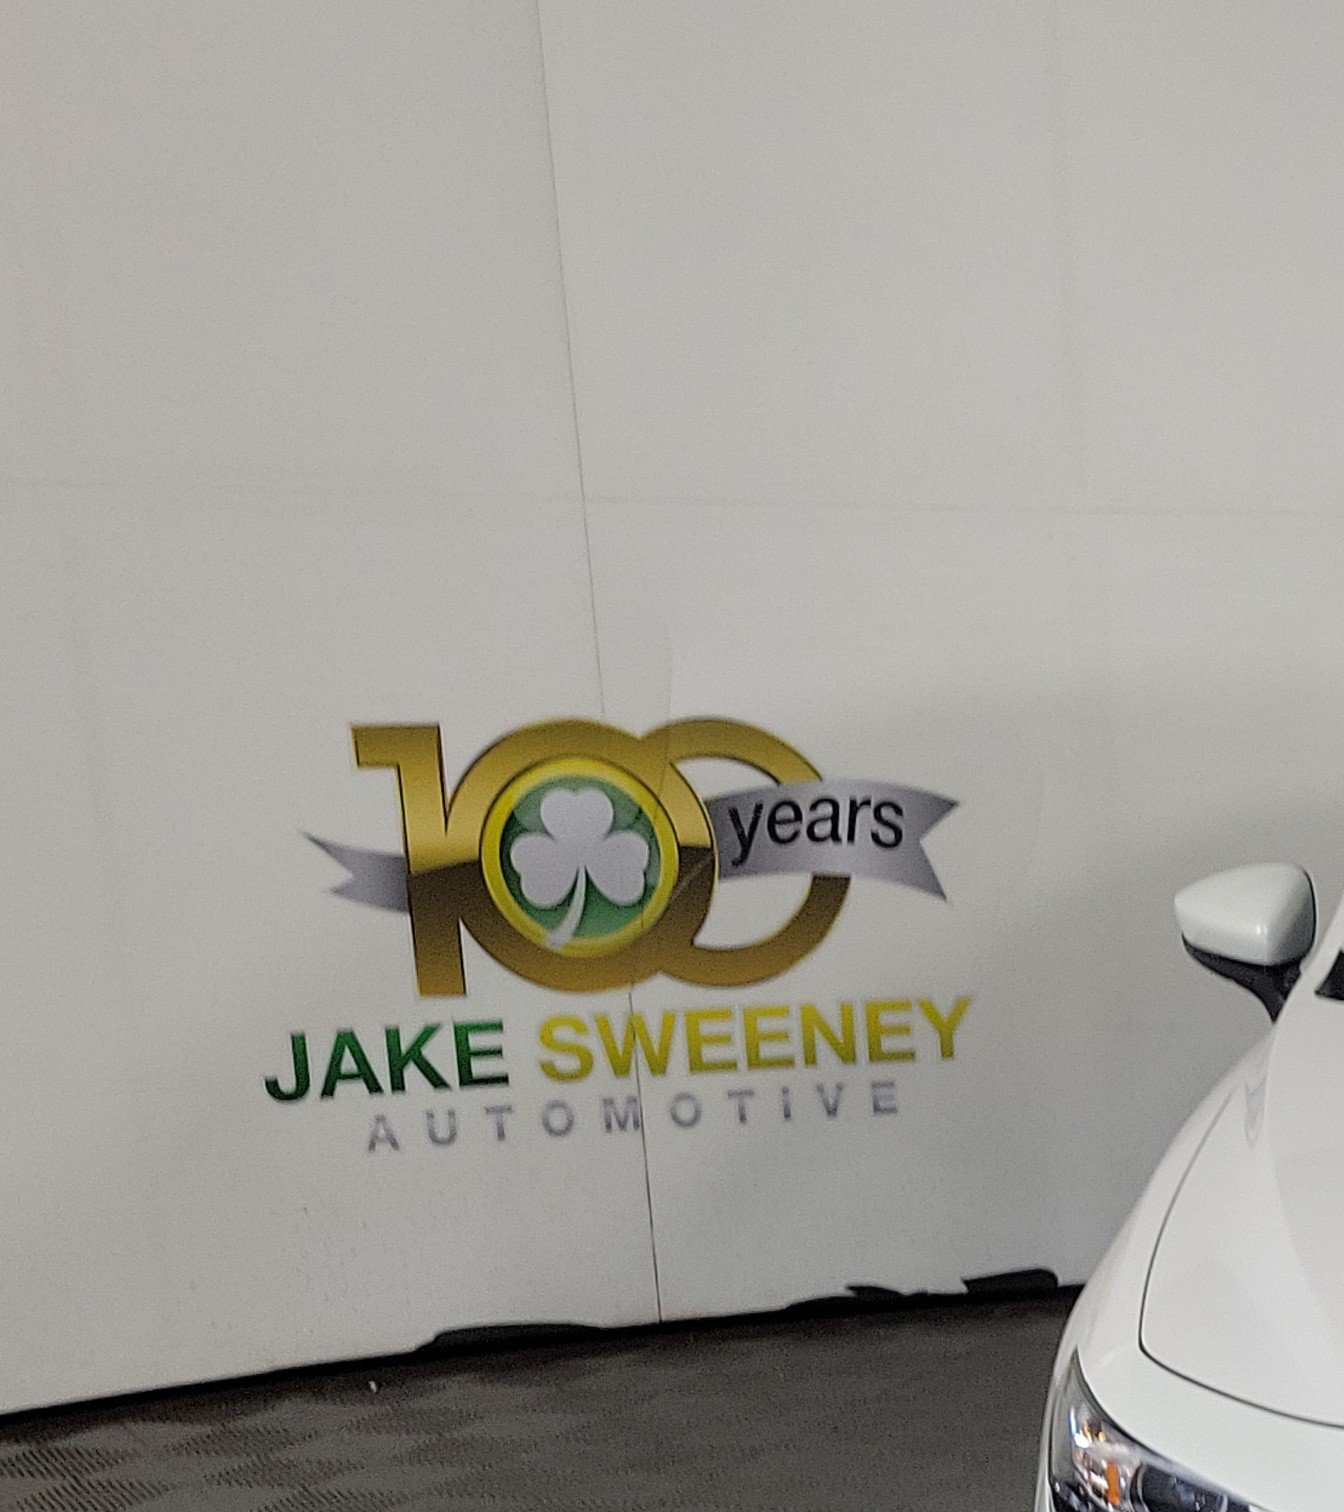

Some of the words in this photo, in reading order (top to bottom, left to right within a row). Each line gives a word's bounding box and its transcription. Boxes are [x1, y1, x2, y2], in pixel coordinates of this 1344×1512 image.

[350, 717, 852, 998] 100
[727, 796, 907, 868] years
[264, 1019, 510, 1104] JAKE
[536, 997, 974, 1084] SWEENEY
[366, 1080, 899, 1154] AUTOMOTIVE
